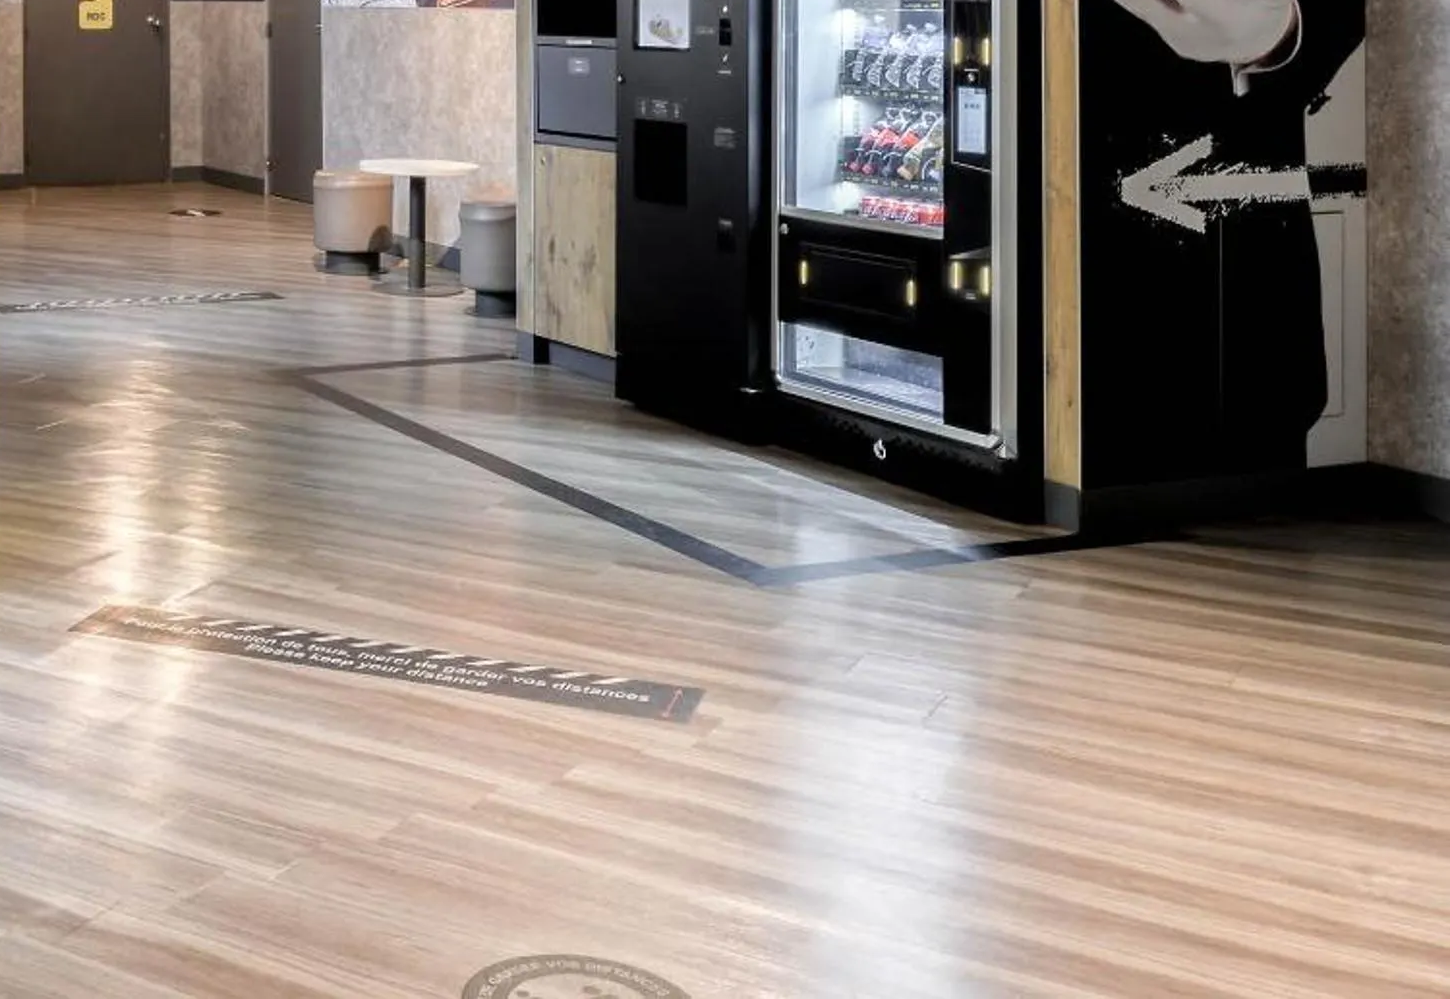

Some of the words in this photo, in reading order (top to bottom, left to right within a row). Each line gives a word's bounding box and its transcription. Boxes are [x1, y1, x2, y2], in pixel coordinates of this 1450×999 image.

[281, 640, 304, 650] de
[357, 652, 412, 666] merci
[414, 660, 439, 670] de
[512, 675, 547, 687] vos
[552, 681, 650, 703] distances
[310, 653, 355, 668] keep
[355, 661, 405, 675] your
[406, 668, 489, 687] distance
